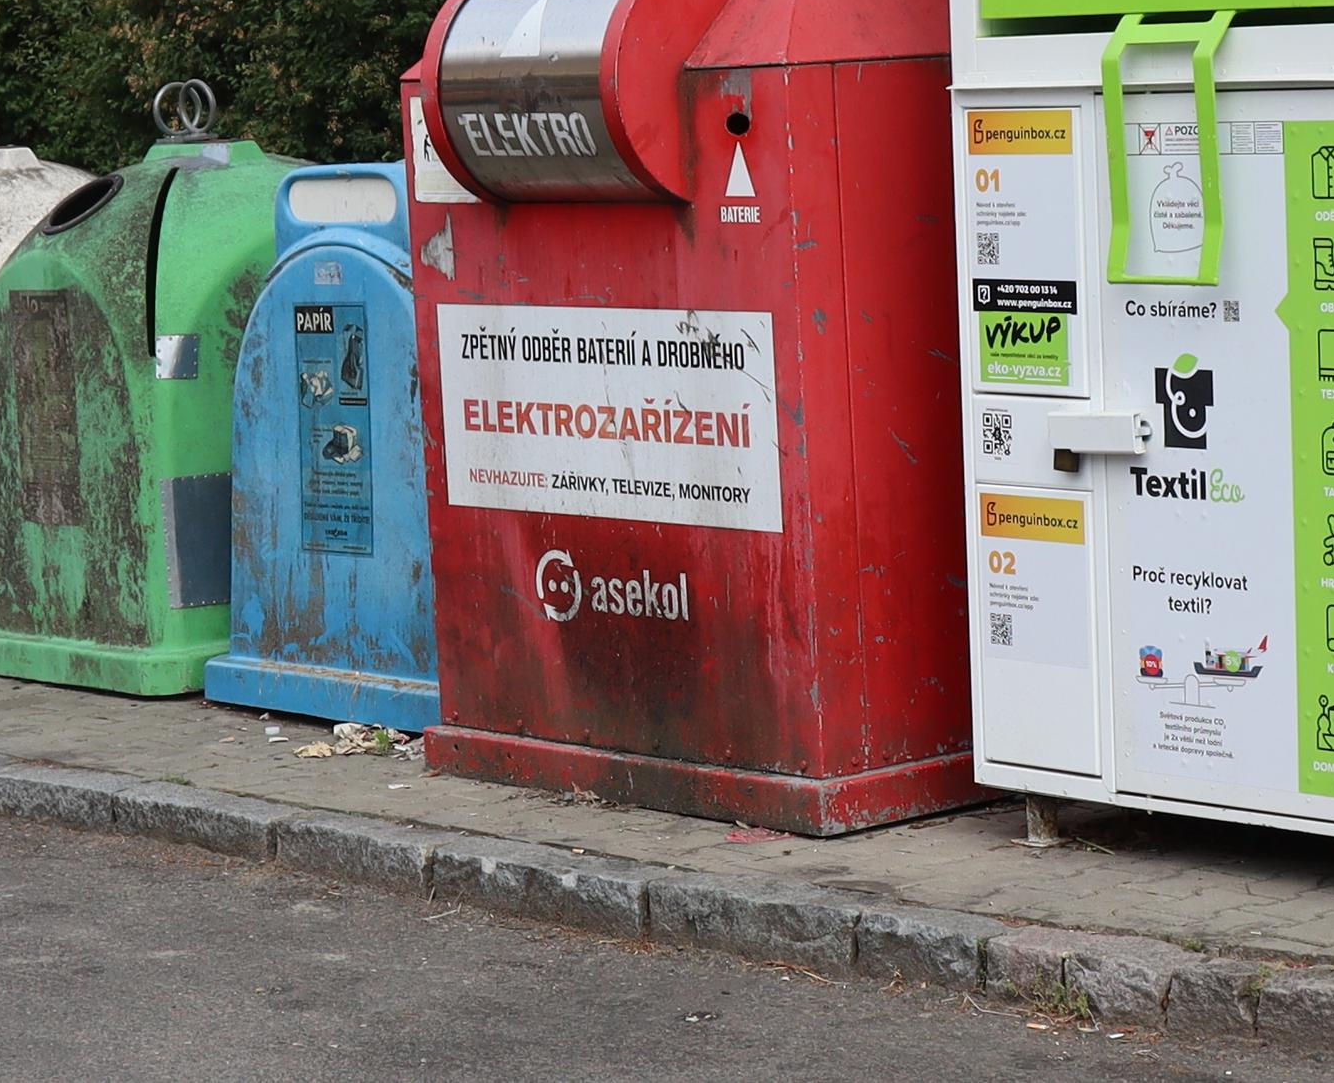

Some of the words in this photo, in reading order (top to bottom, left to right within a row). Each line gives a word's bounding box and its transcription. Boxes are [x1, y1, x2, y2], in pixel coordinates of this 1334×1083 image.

[457, 112, 598, 157] ELEKTRO
[986, 126, 1066, 143] penguinbox.cz
[1175, 125, 1199, 136] POZO
[976, 168, 1000, 193] 01
[720, 205, 761, 223] BATERIE
[997, 284, 1014, 294] +420
[1015, 285, 1029, 294] 702
[1030, 285, 1040, 294] 00
[1050, 286, 1058, 295] 14
[997, 298, 1072, 309] www.penguinbox.cz
[1125, 300, 1146, 317] Co
[1151, 300, 1217, 319] sbíráme?
[296, 307, 333, 332] PAPÍR
[985, 315, 1061, 349] VÝKUP
[461, 326, 516, 362] ZPĚTNÝ
[522, 329, 571, 363] ODBĚR
[578, 331, 636, 366] BATERIÍ
[642, 341, 652, 366] A
[658, 333, 745, 370] DROBNÉHO
[987, 362, 1061, 380] eko-vyzva.cz
[463, 397, 751, 448] ELEKTROZAŘÍZENÍ
[469, 468, 548, 488] NEVHAZUJTE:
[551, 470, 609, 495] ZÁŘIVKY,
[612, 477, 675, 500] TELEVIZE,
[679, 483, 751, 505] MONITORY
[999, 513, 1078, 529] penguinbox.cz
[989, 550, 1016, 575] 02
[1132, 565, 1166, 584] Proč
[1170, 571, 1248, 591] recyklovat
[590, 569, 689, 621] asekol
[1168, 596, 1212, 614] textil?
